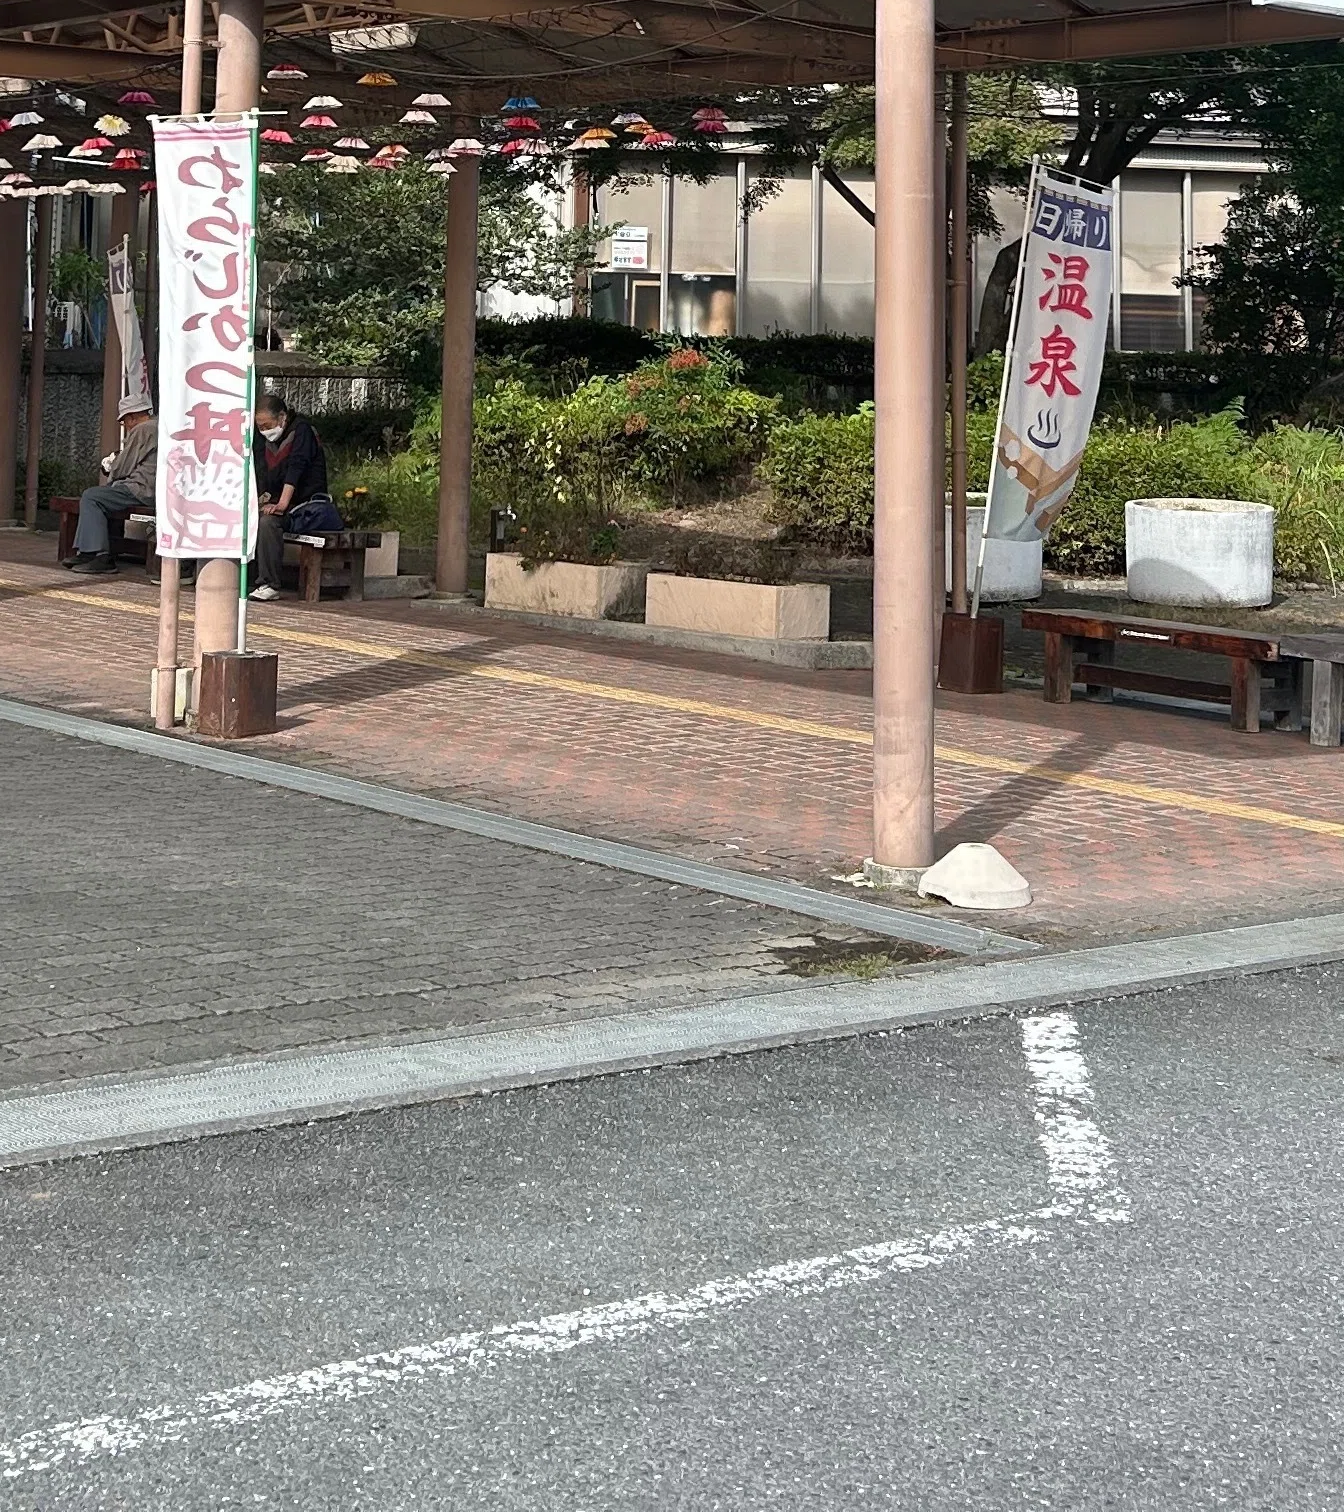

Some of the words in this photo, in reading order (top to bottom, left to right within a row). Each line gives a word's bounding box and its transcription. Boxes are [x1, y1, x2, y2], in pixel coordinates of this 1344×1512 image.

[1035, 200, 1107, 248] 日帰り
[1024, 252, 1094, 398] 温泉
